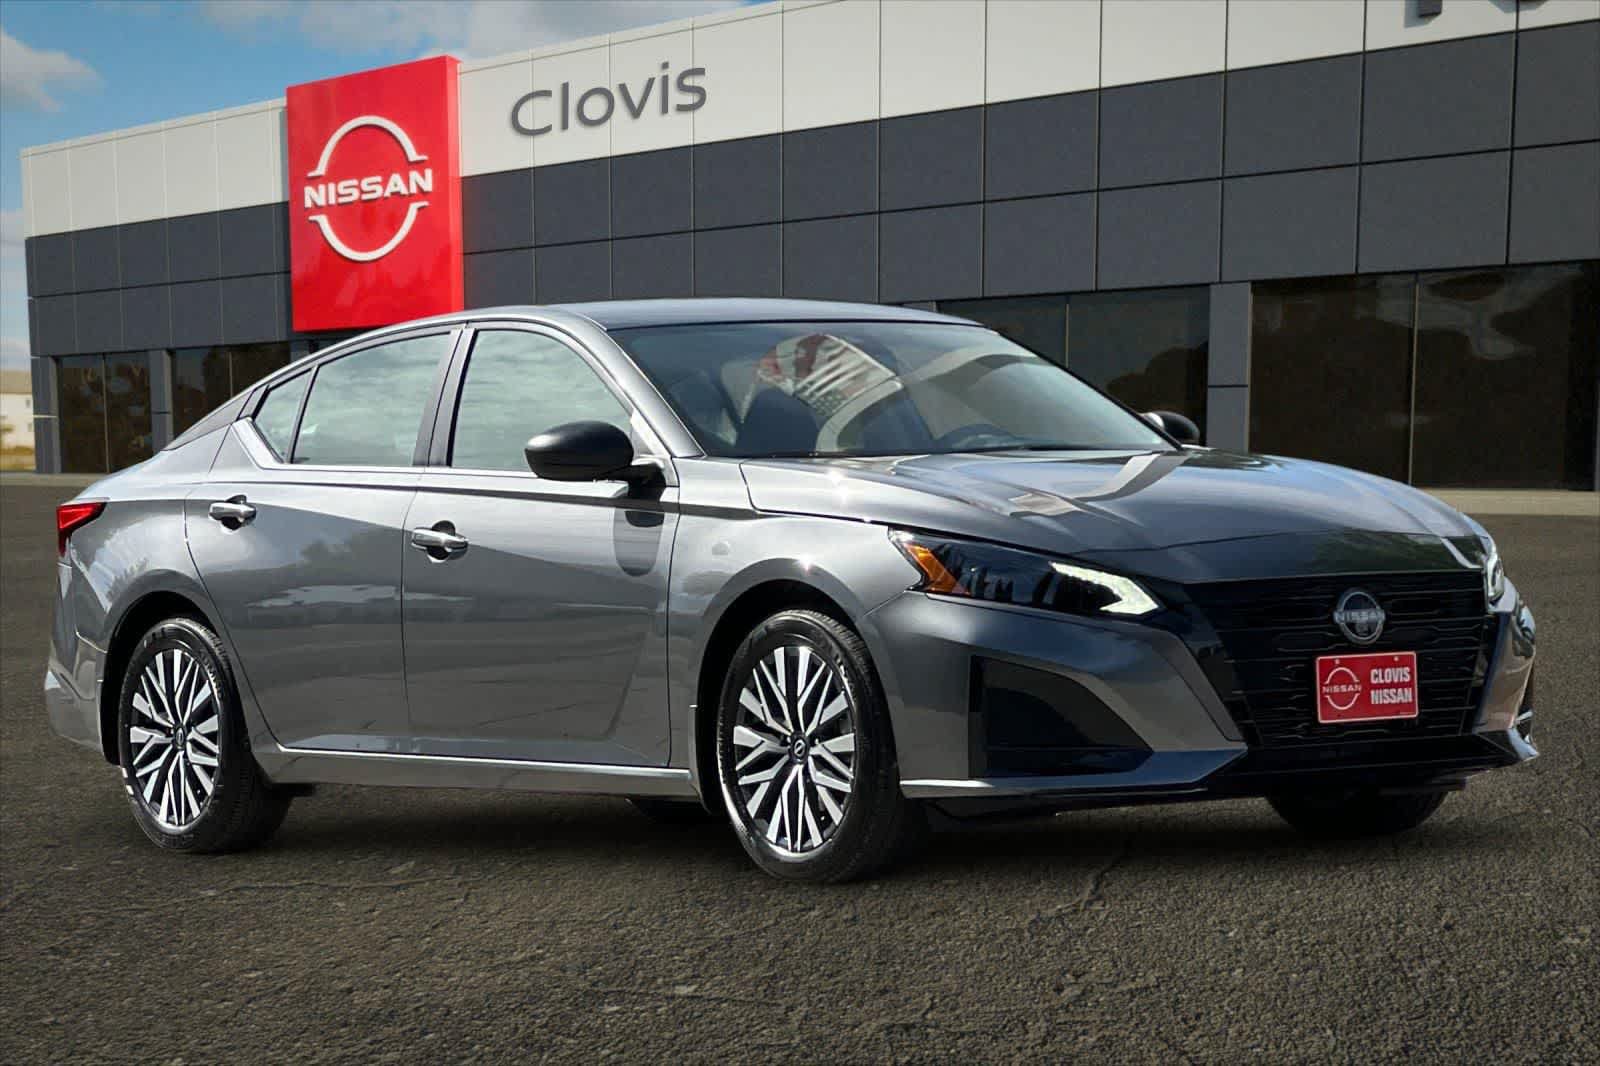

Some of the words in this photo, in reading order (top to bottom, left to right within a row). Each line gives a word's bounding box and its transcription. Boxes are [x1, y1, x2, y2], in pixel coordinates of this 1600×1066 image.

[511, 61, 708, 136] Clovis
[304, 168, 433, 209] NISSAN
[1333, 610, 1385, 623] NISSAN
[1371, 667, 1410, 684] CLOVIS
[1323, 685, 1362, 693] NISSAN
[1371, 688, 1412, 704] NISSAN
